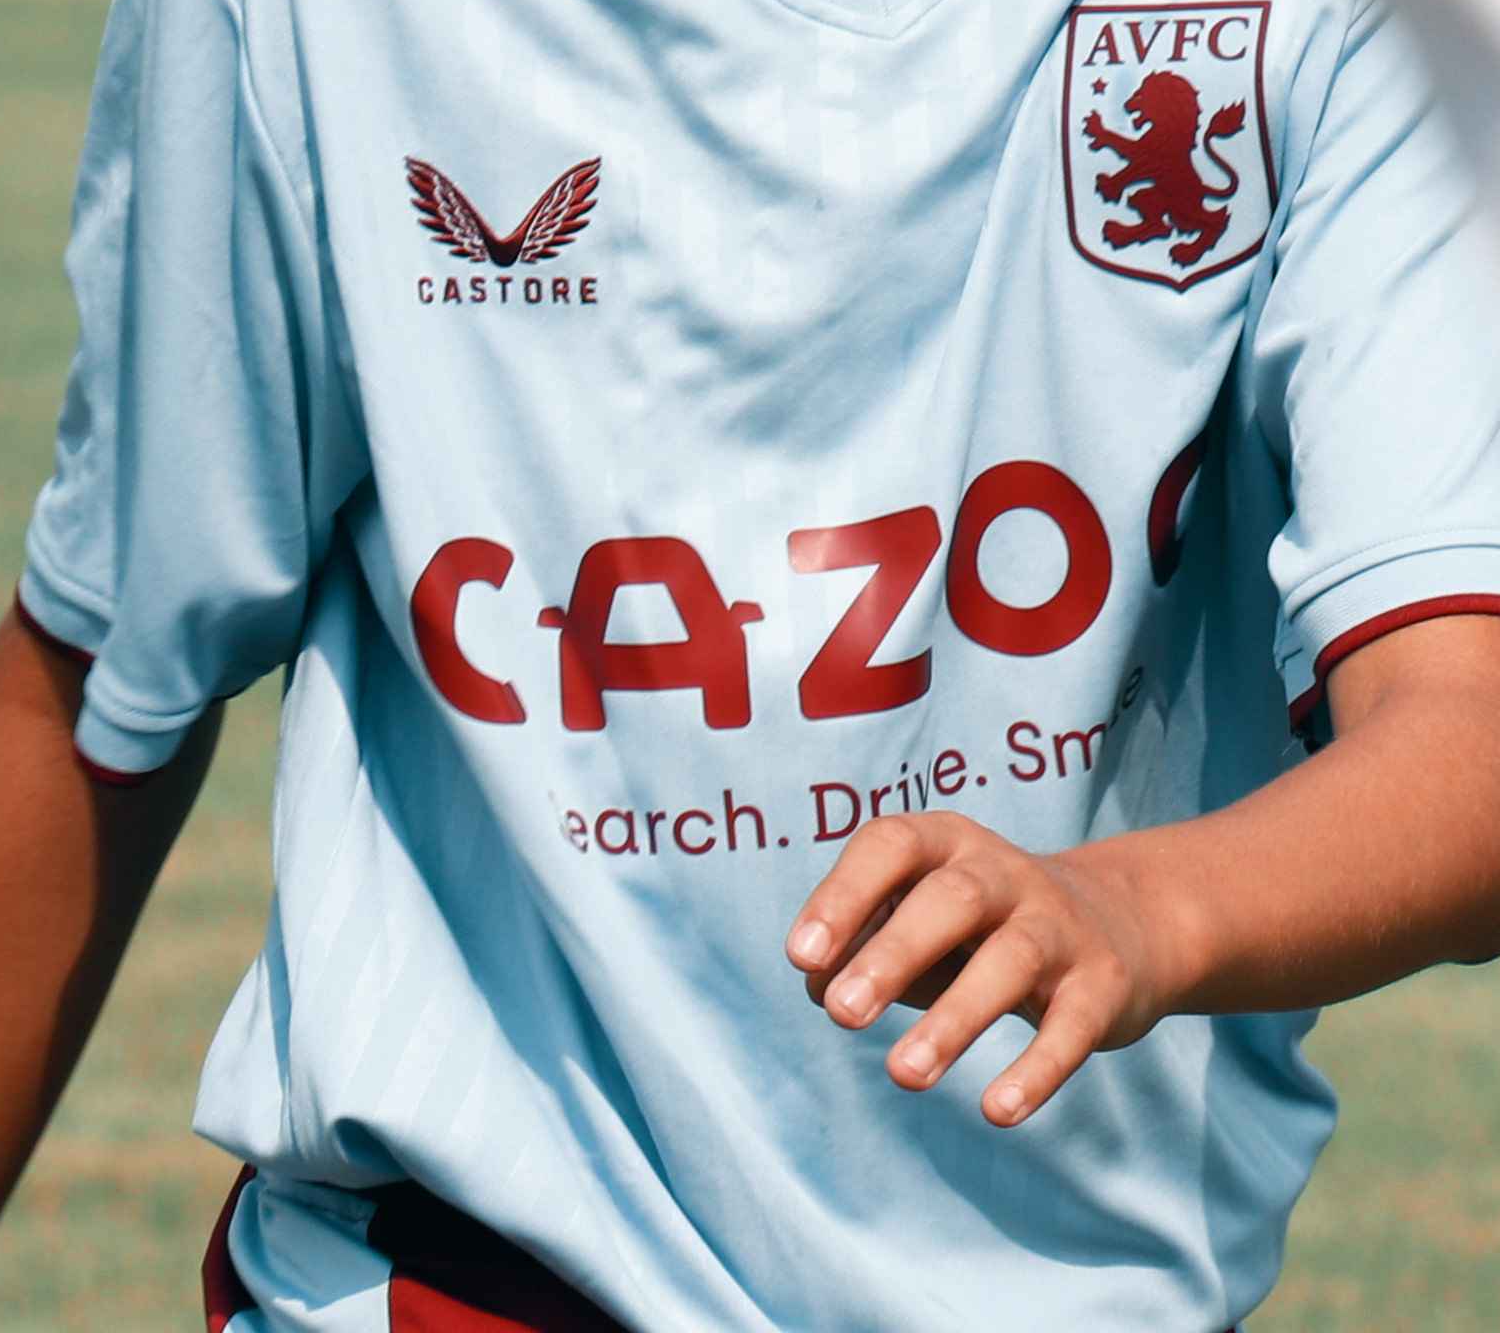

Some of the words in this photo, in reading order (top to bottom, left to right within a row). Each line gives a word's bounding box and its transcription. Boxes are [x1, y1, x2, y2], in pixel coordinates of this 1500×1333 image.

[1082, 16, 1250, 67] AVFC
[417, 275, 599, 305] CASTORE
[550, 788, 790, 856] earch.
[809, 748, 988, 843] Drive.
